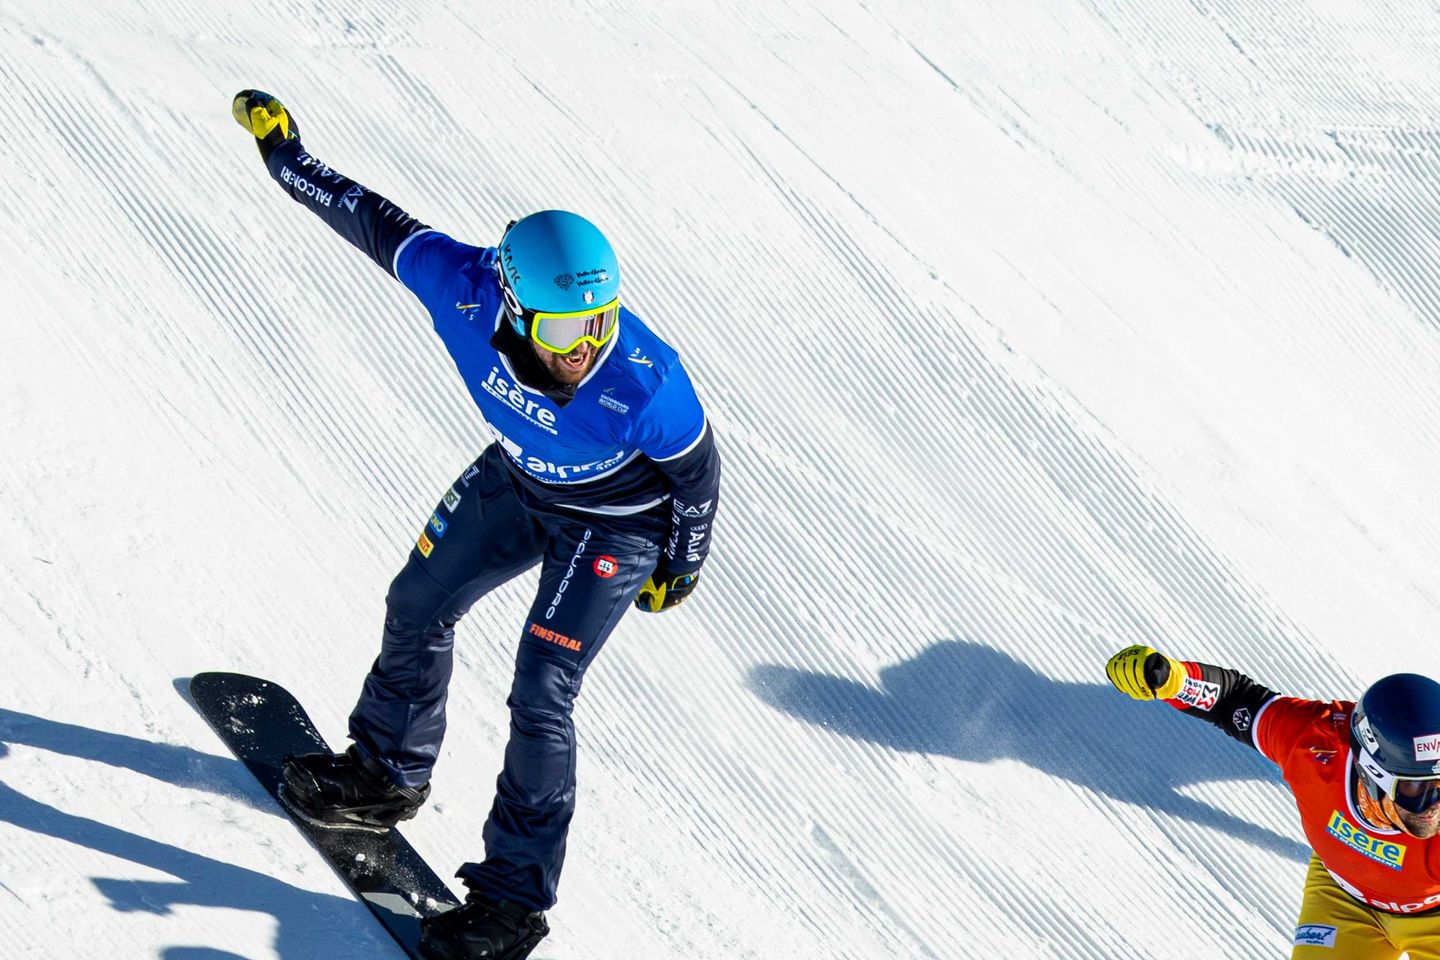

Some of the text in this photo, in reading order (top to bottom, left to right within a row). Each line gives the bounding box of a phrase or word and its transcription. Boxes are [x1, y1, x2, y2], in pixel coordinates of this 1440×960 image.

[281, 165, 333, 208] FALCONERI
[486, 366, 556, 427] isère
[545, 528, 592, 620] PIQUADRO
[530, 623, 583, 652] FINSTRAL
[1331, 811, 1401, 862] isère
